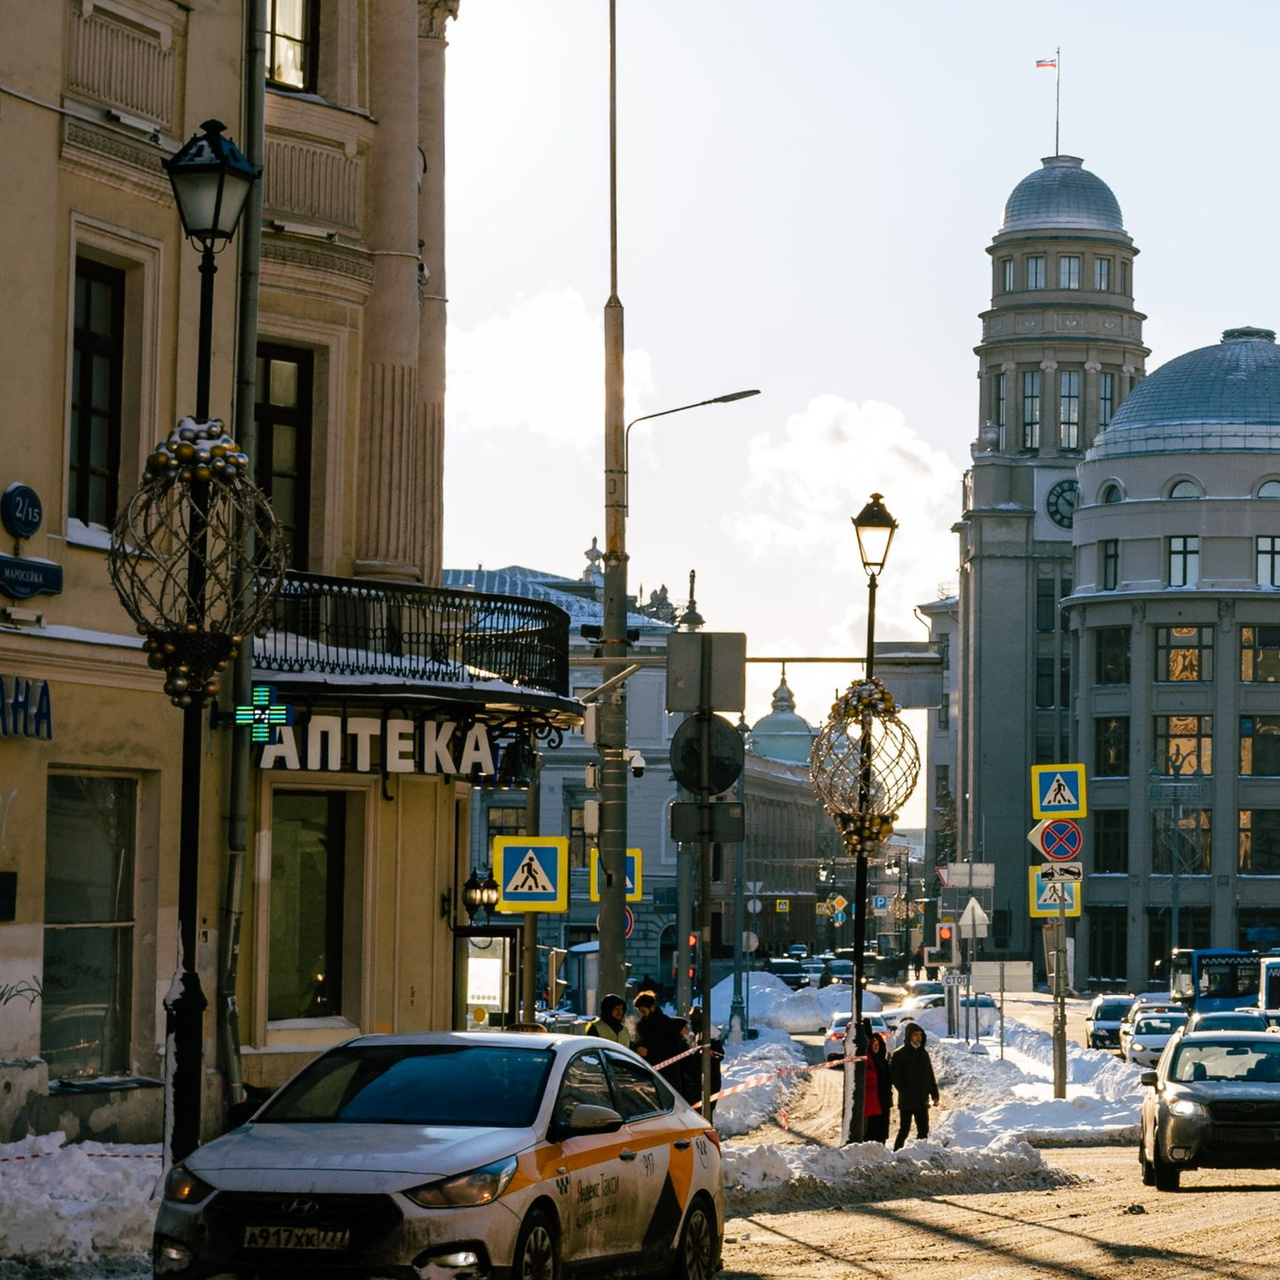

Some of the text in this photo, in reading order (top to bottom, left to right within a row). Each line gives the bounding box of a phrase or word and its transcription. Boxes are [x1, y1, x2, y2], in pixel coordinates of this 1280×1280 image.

[15, 496, 40, 523] 2/15
[4, 567, 43, 584] МАРОСЕЙКА
[258, 714, 496, 776] АПТЕКА
